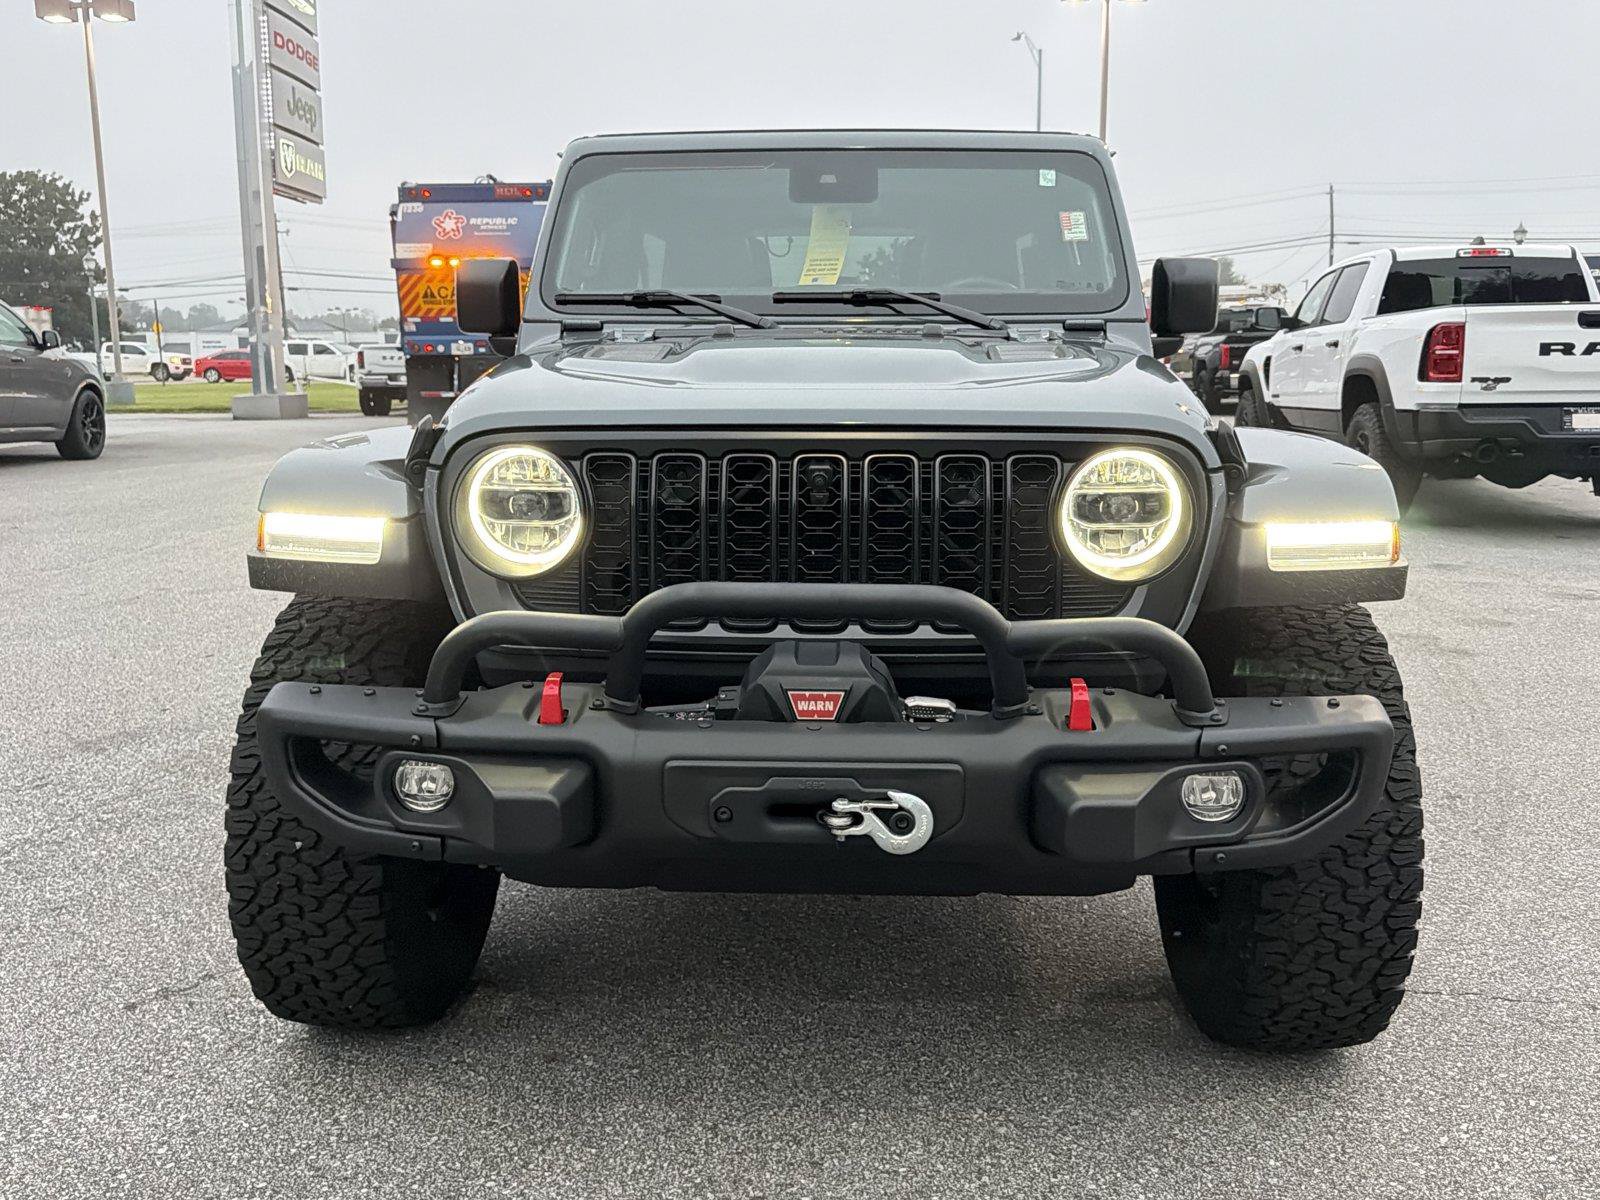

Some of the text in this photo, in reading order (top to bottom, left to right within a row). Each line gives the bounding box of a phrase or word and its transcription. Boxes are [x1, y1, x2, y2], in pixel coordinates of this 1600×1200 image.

[273, 30, 319, 72] DODGE
[286, 85, 317, 132] Jeep
[296, 154, 324, 181] RAM
[469, 217, 518, 225] REPUBLIC
[797, 700, 834, 711] WARN
